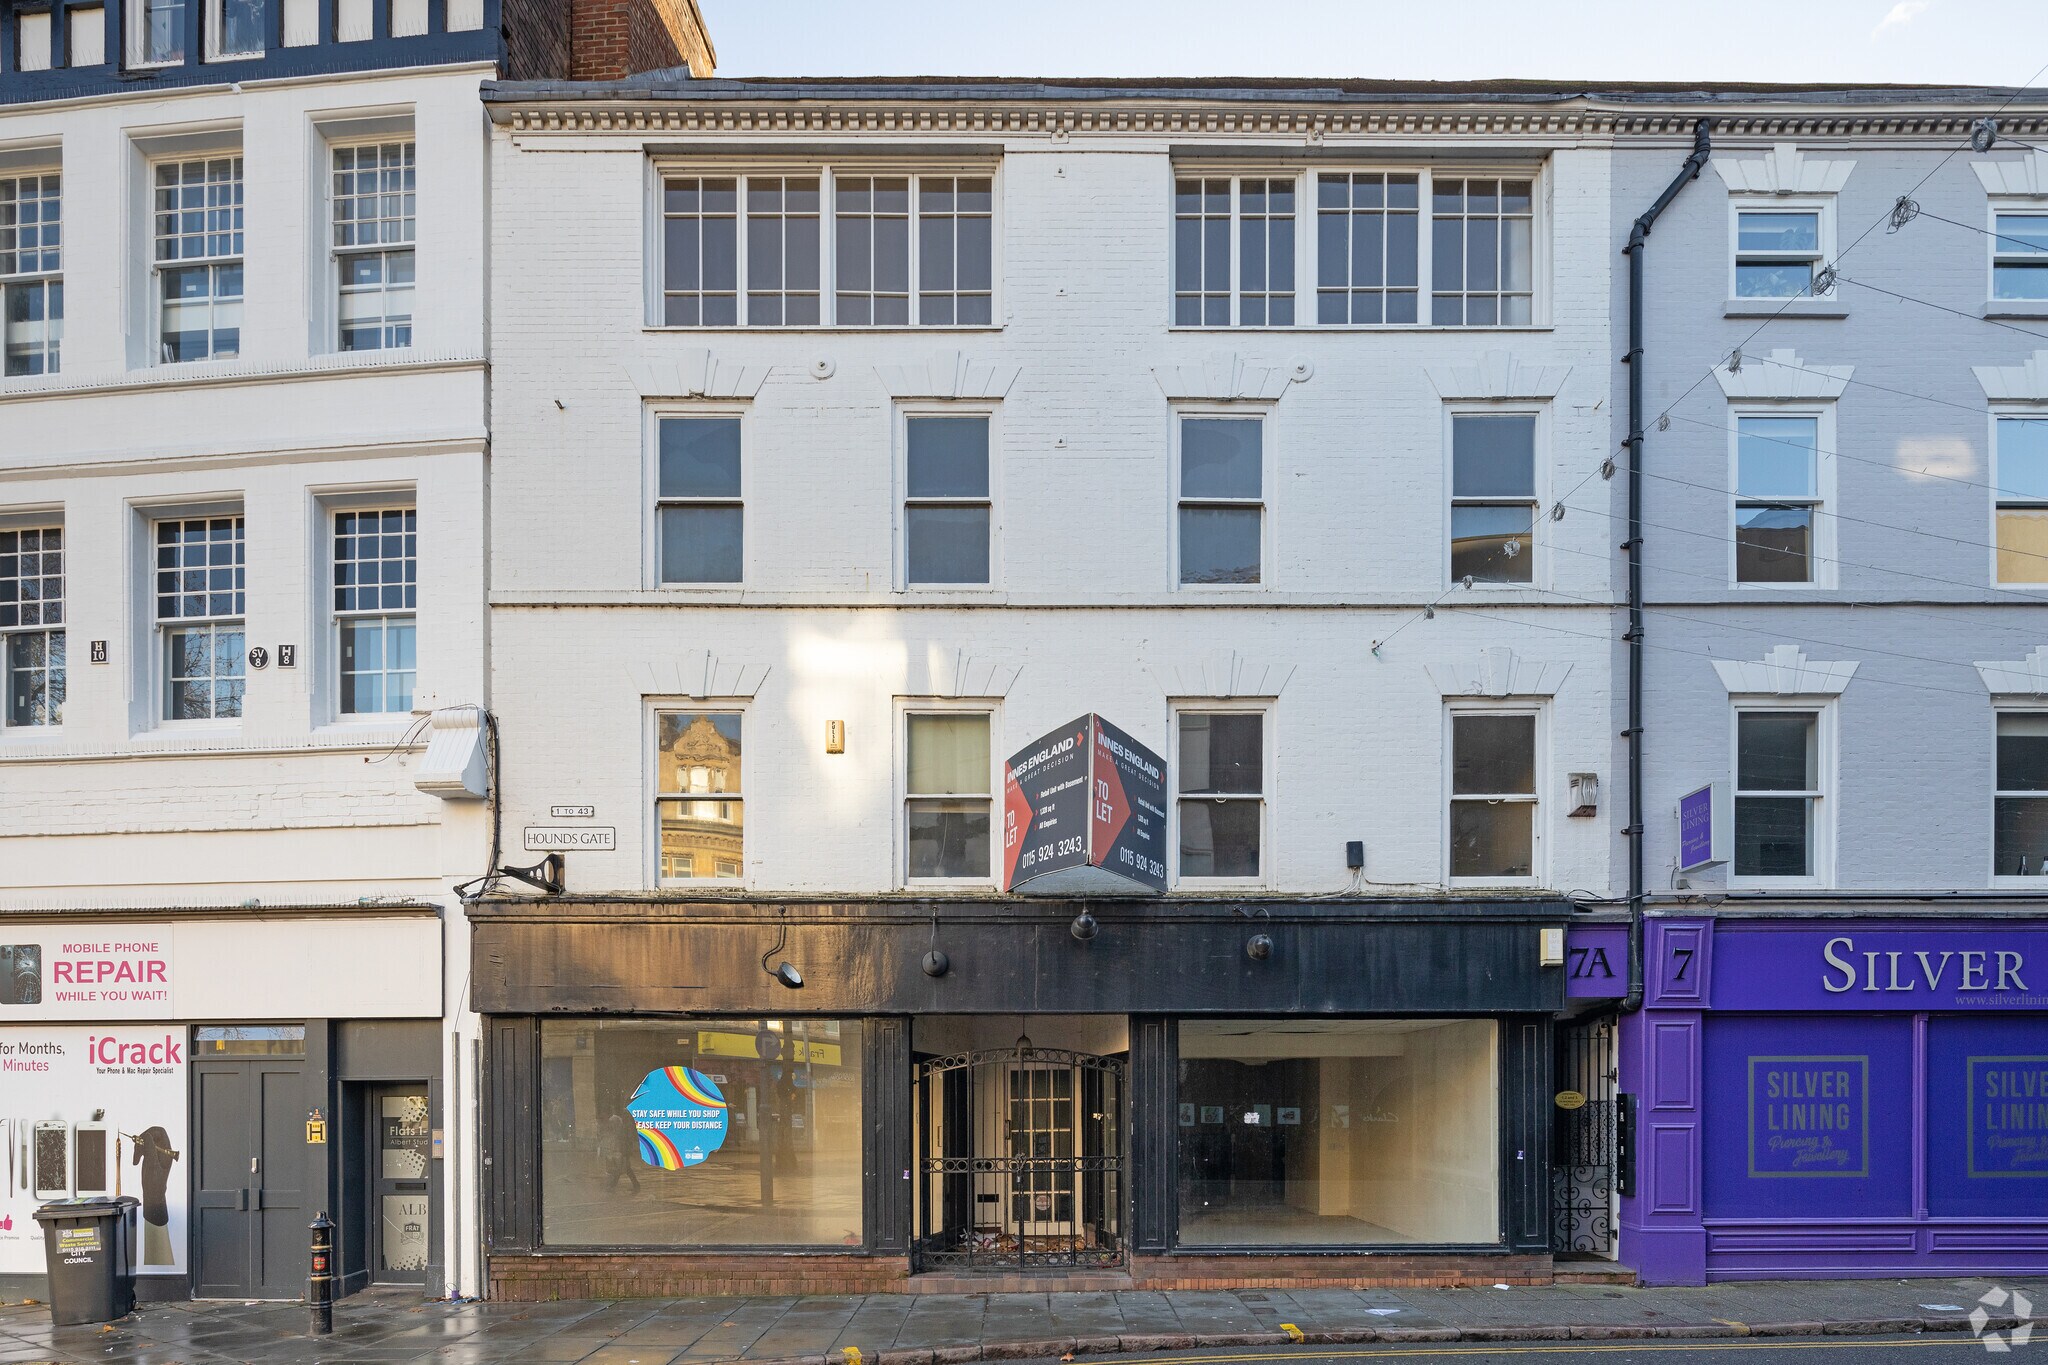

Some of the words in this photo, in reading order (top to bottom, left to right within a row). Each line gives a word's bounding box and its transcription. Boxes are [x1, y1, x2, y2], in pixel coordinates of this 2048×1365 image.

[93, 651, 104, 660] 10
[252, 649, 264, 658] SV
[282, 646, 291, 656] H
[283, 656, 290, 664] 8
[255, 659, 261, 667] 8
[1007, 761, 1028, 784] INNES
[1028, 737, 1074, 770] ENGLAND
[1098, 732, 1123, 757] INNES
[1124, 748, 1159, 780] ENGLAND
[1024, 769, 1040, 782] GREAT
[1043, 753, 1074, 772] DECISION
[1097, 749, 1112, 762] MAKE
[1120, 762, 1136, 776] GREAT
[1138, 773, 1160, 790] DECISION
[1097, 778, 1108, 801] TO
[1006, 809, 1015, 829] TO
[1096, 800, 1113, 824] LET
[1682, 813, 1709, 831] LINING
[1683, 803, 1708, 819] SILVER
[528, 833, 578, 844] HOUNDS
[581, 833, 610, 844] GATE
[1006, 826, 1018, 848] LET
[1022, 852, 1035, 869] 0115
[1038, 843, 1054, 862] 924
[1058, 836, 1082, 856] 3243
[1120, 847, 1134, 866] 0115
[1136, 854, 1148, 871] 924
[1149, 859, 1164, 878] 3243
[62, 943, 110, 953] MOBILE
[114, 942, 158, 952] PHONE
[54, 960, 167, 983] REPAIR
[1569, 946, 1616, 978] 7A
[1673, 947, 1693, 980] 7
[1823, 937, 2029, 992] SILVER
[56, 991, 96, 1001] WHILE
[100, 991, 127, 1000] YOU
[132, 990, 167, 1000] WAIT!
[19, 1042, 65, 1056] Months,
[89, 1035, 182, 1065] iCrack
[4, 1059, 49, 1071] Minutes
[1768, 1071, 1850, 1098] SILVER
[1986, 1071, 2048, 1098] SILVE
[1768, 1103, 1850, 1130] LINING
[1986, 1103, 2048, 1130] LININ
[390, 1126, 415, 1136] Flats
[1768, 1135, 1820, 1152] Piercing
[1822, 1136, 1832, 1148] &
[1792, 1148, 1850, 1167] Jewellery
[399, 1204, 426, 1215] ALB
